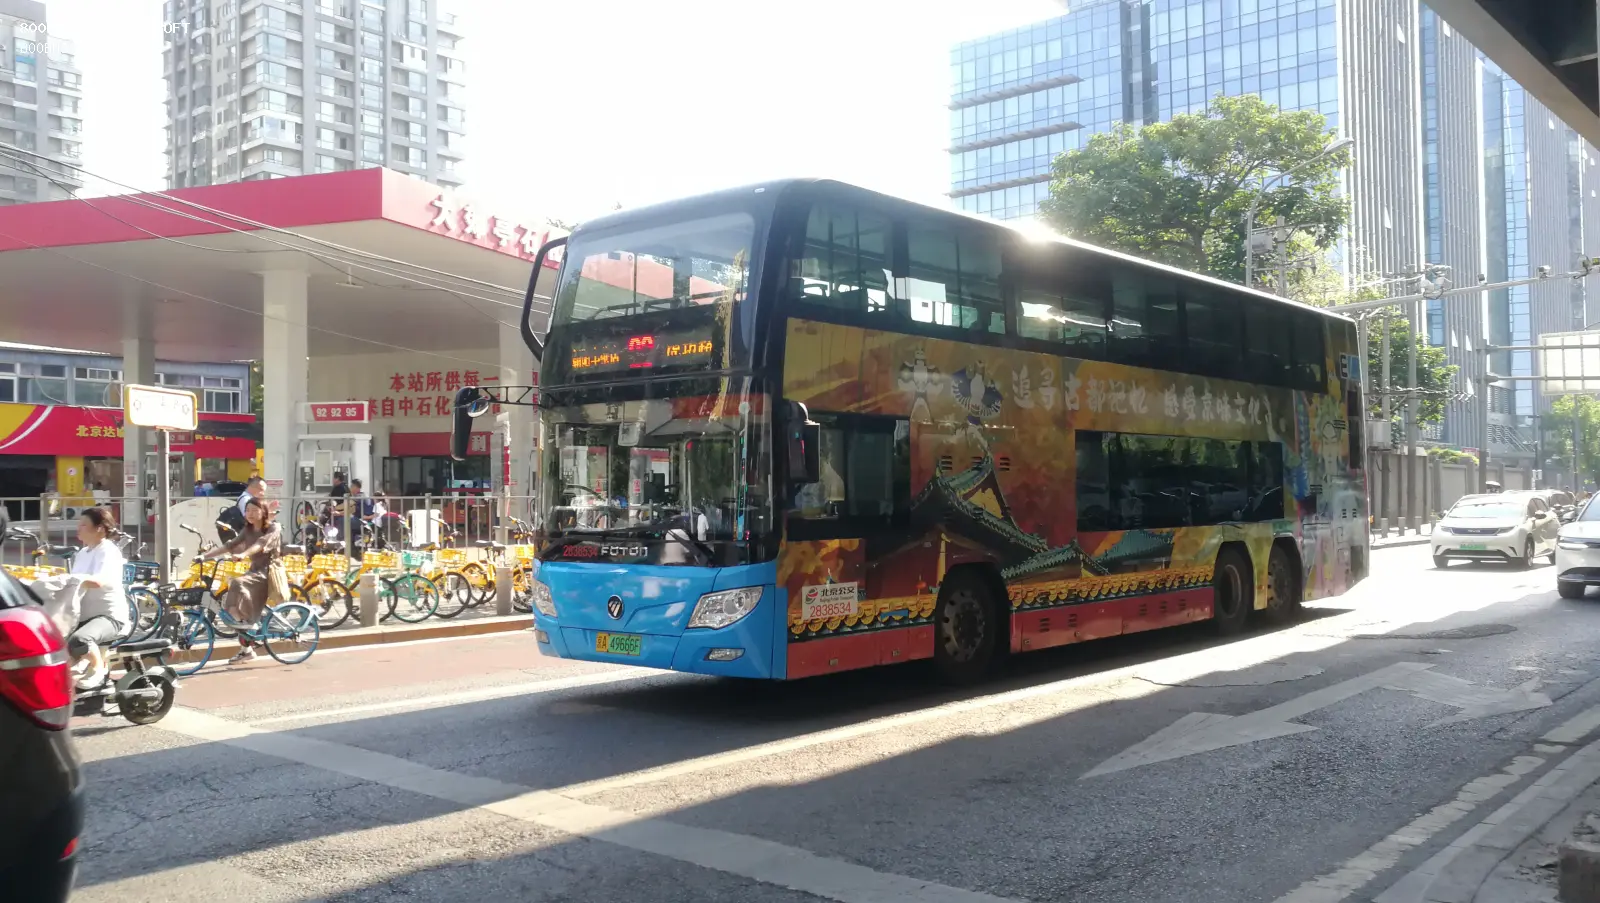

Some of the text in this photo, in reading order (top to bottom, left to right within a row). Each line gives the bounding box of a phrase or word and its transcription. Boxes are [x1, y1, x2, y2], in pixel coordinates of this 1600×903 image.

[389, 370, 499, 393] 本站所供每一
[316, 407, 357, 418] 92 92 95
[562, 544, 598, 558] 2838534
[601, 545, 648, 557] FOTON
[820, 586, 855, 597] 北京公交
[809, 600, 852, 618] 2838534
